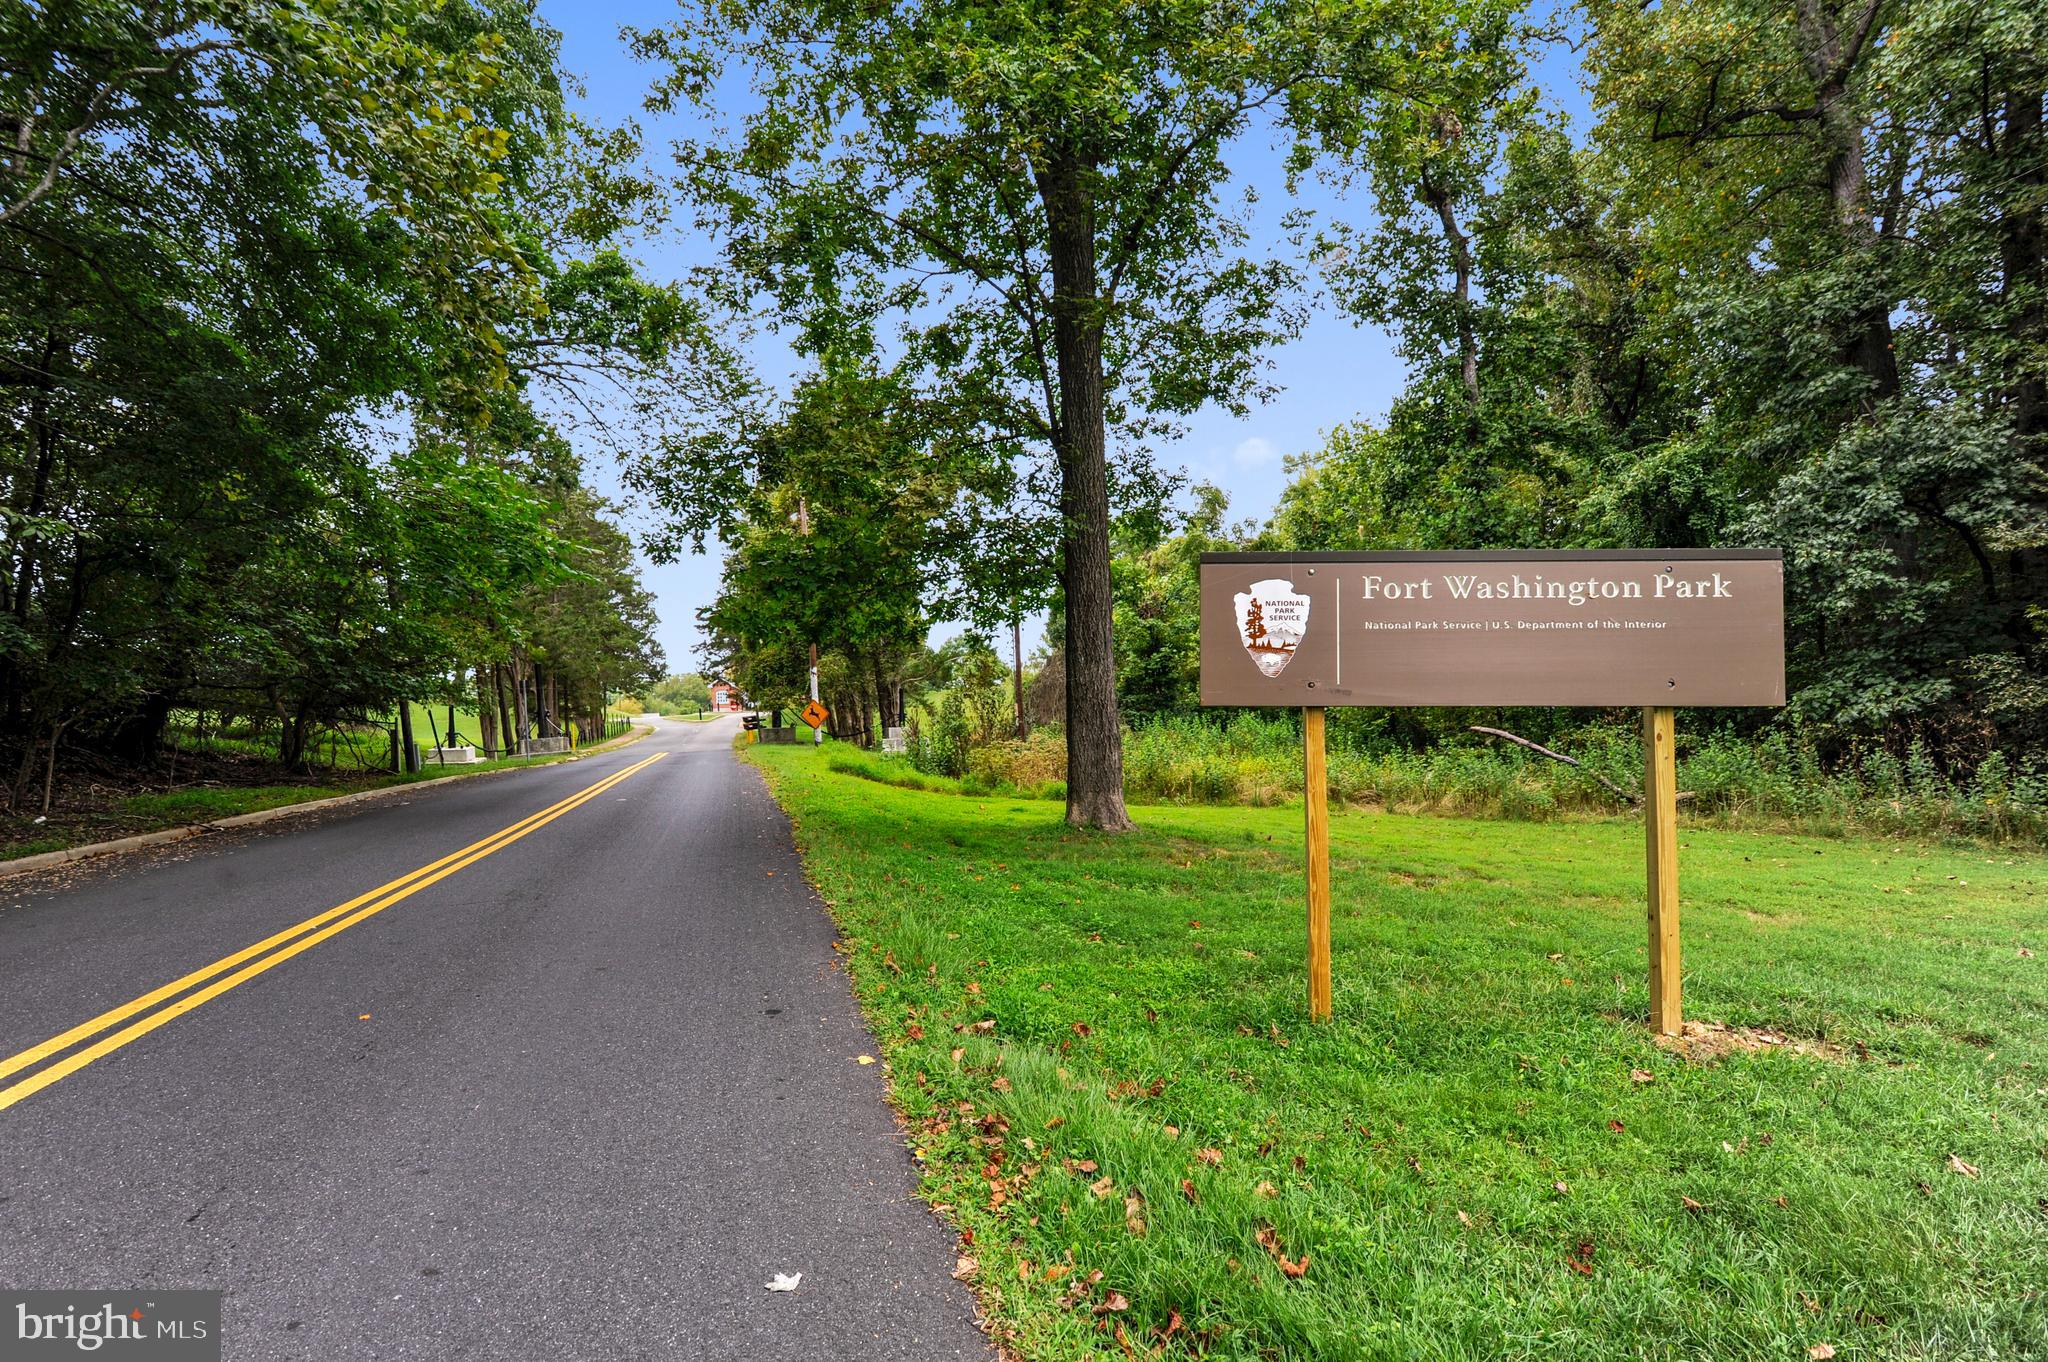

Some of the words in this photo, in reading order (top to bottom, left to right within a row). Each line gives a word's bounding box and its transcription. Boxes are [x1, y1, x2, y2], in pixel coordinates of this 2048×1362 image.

[1362, 575, 1433, 599] Fort
[1443, 574, 1643, 606] Washington
[1653, 572, 1733, 598] Park
[1365, 620, 1411, 630] National
[1415, 620, 1439, 630] Park
[1442, 620, 1482, 630] Service
[1492, 620, 1513, 630] U.S.
[1517, 619, 1583, 631] Department
[1587, 619, 1599, 629] of
[1602, 619, 1621, 629] the
[1624, 619, 1667, 629] Interior
